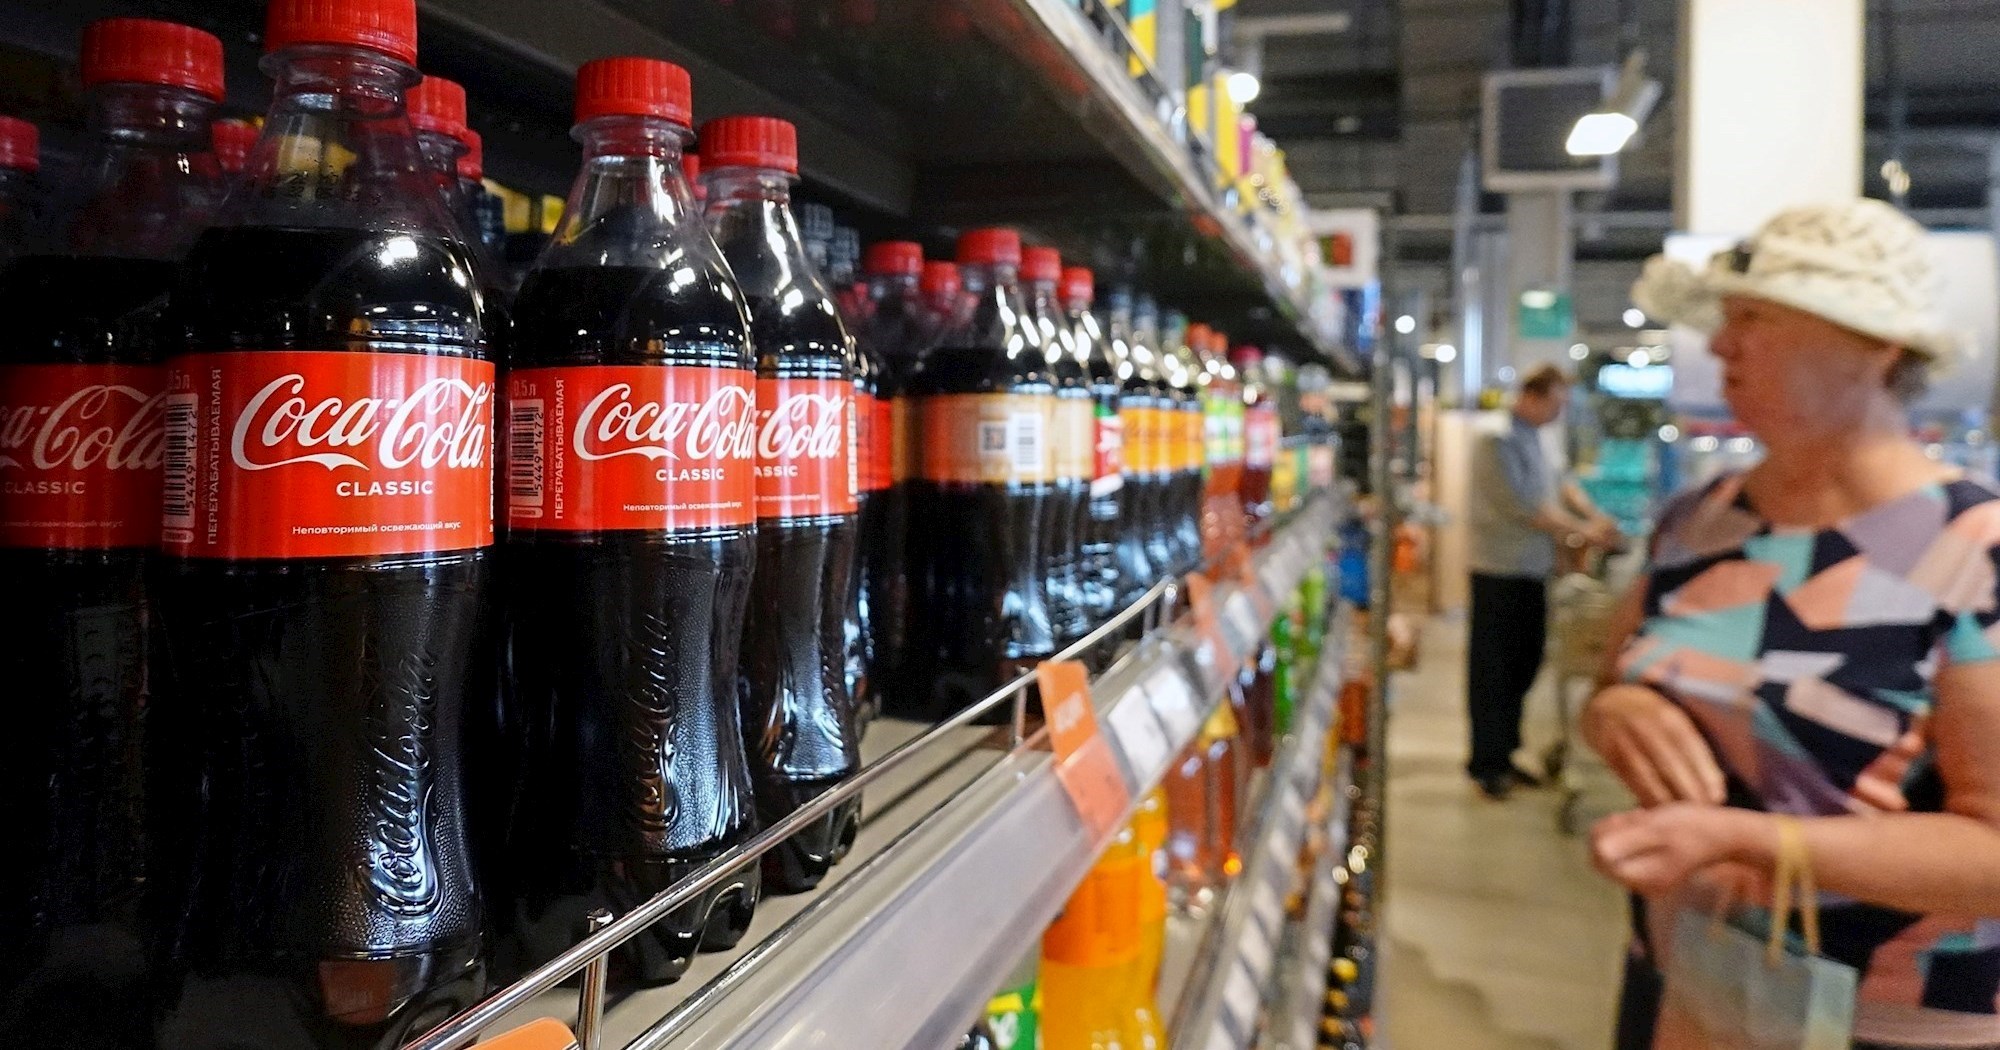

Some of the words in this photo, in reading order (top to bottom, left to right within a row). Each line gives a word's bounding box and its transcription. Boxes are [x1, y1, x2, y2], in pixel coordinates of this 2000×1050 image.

[0, 384, 169, 471] a-Cola
[231, 373, 489, 471] Coca-Cola
[534, 412, 544, 446] 1472
[573, 382, 756, 461] Coca-Cola
[757, 393, 846, 460] -Cola
[207, 369, 222, 545] ПЕРЕРАБАТЫВАЕМАЯ
[555, 379, 565, 519] ПЕРЕРАБАТЫВАЕМАЯ
[5, 481, 86, 495] CLASSIC
[336, 480, 434, 497] CLASSIC
[534, 455, 543, 491] 5449
[655, 468, 725, 482] CLASSIC
[754, 465, 799, 477] ASSIC
[623, 502, 687, 512] Неповторимый
[292, 523, 378, 535] Неповторимый
[380, 521, 443, 533] освежающий
[444, 520, 461, 531] вкус
